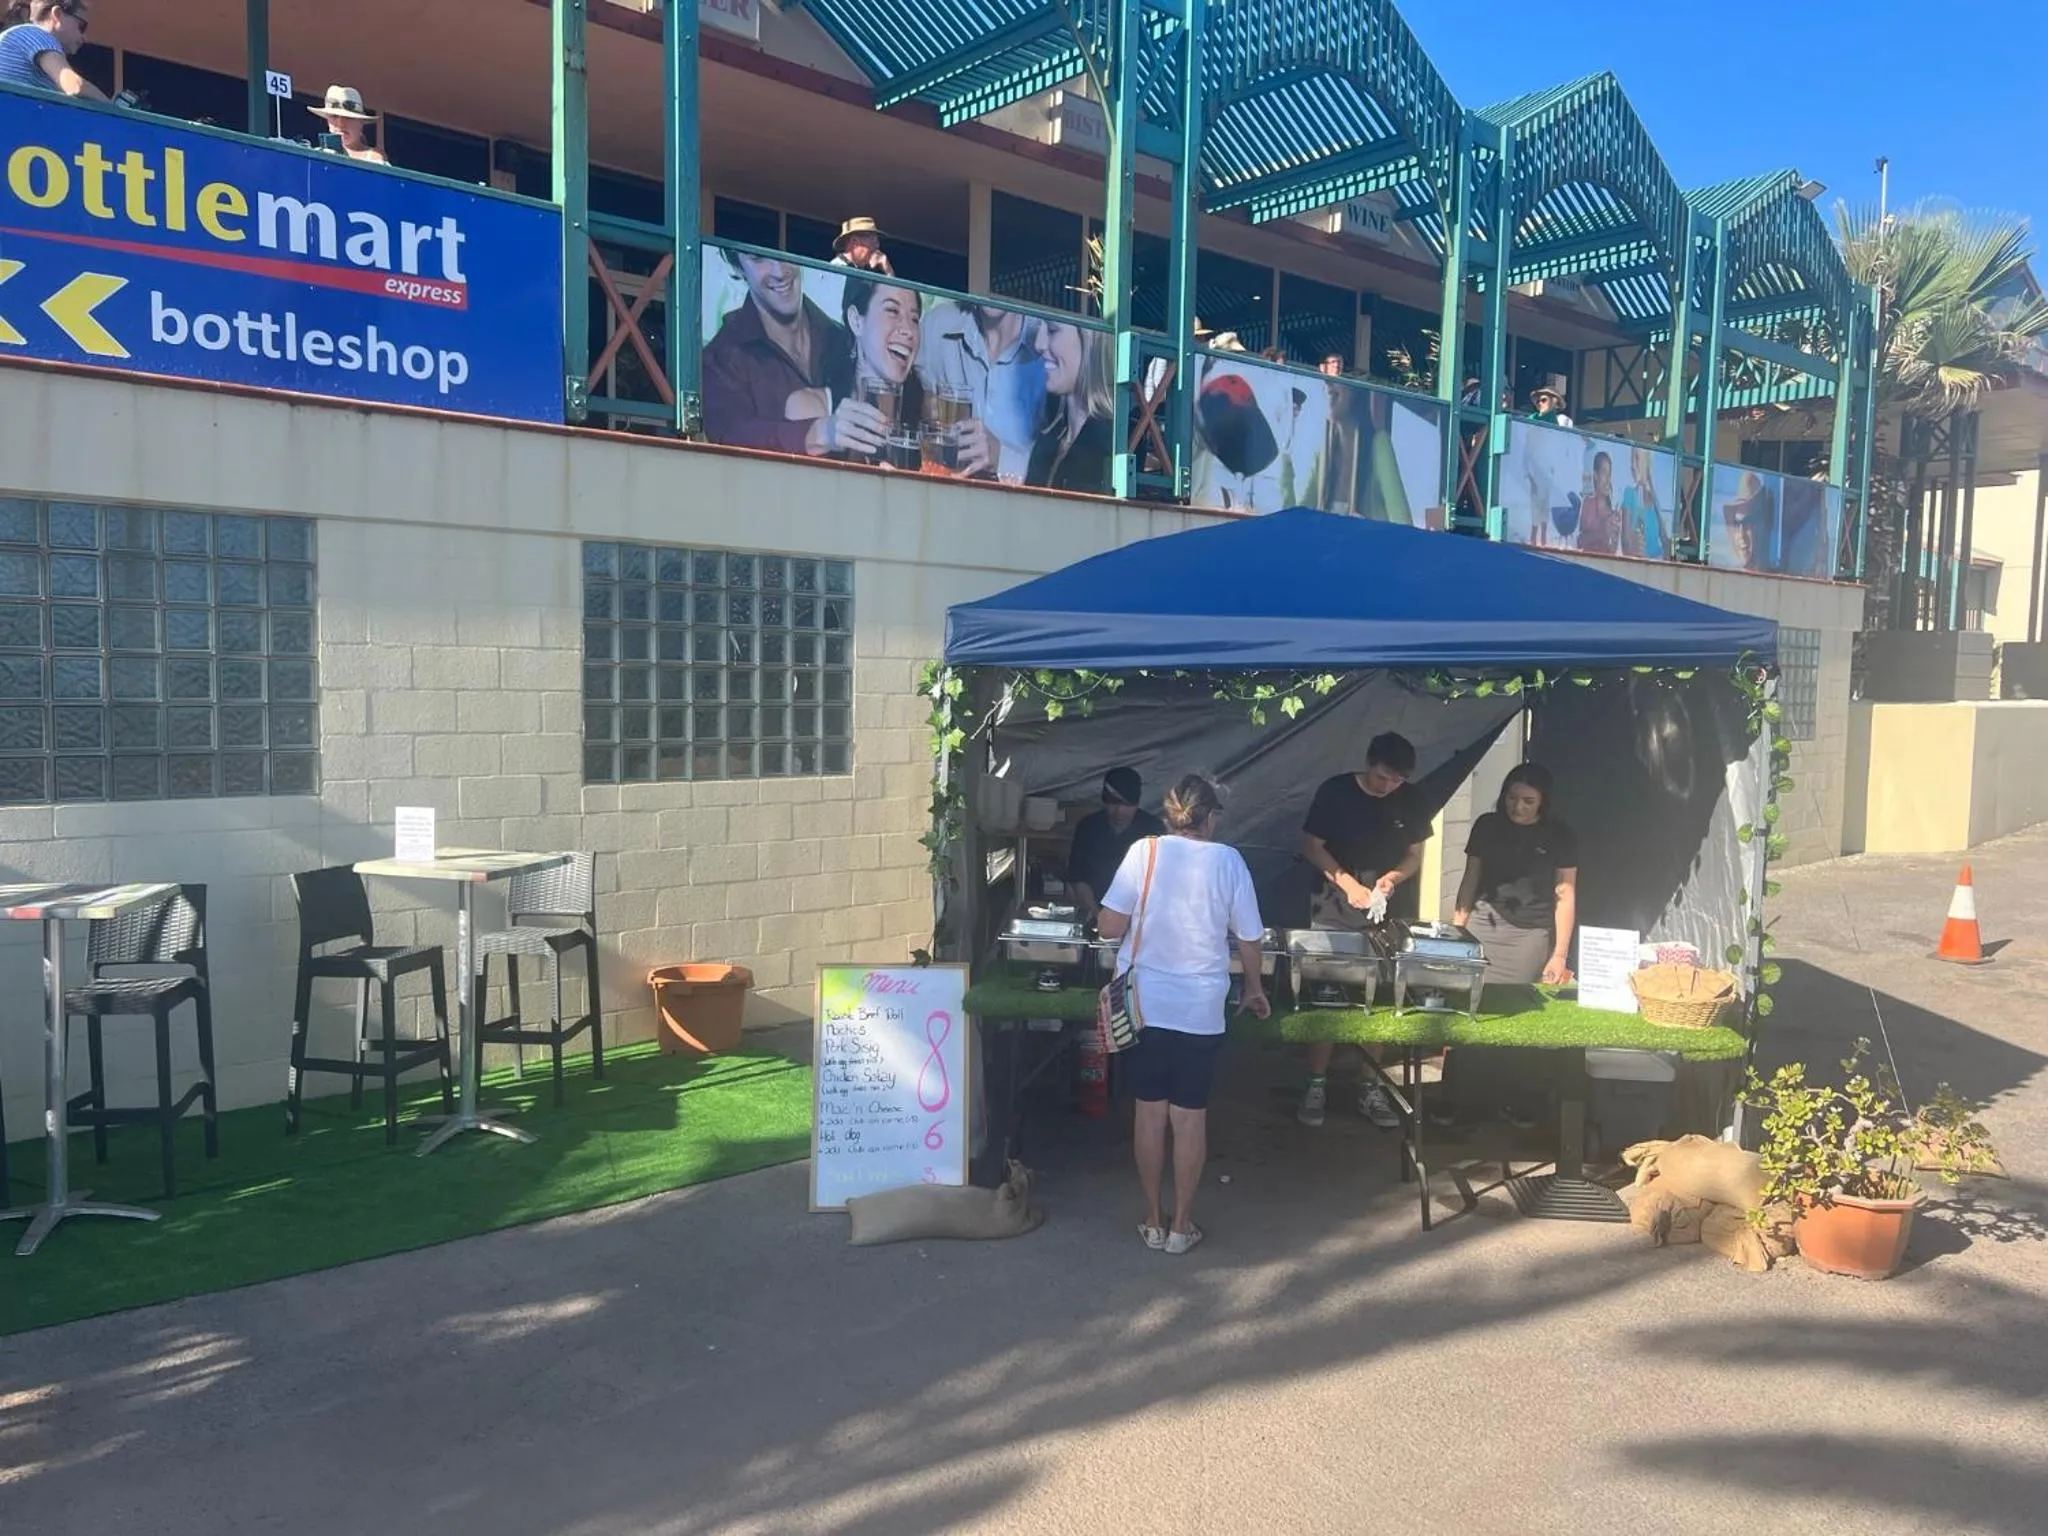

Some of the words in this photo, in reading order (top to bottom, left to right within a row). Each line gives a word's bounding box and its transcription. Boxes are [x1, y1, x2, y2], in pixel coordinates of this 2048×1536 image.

[270, 76, 288, 94] 45
[1347, 203, 1389, 234] WINE
[384, 278, 462, 304] express
[150, 290, 469, 394] bottleshop
[861, 972, 920, 995] Menu
[917, 1010, 951, 1113] 8
[924, 1119, 947, 1150] 6
